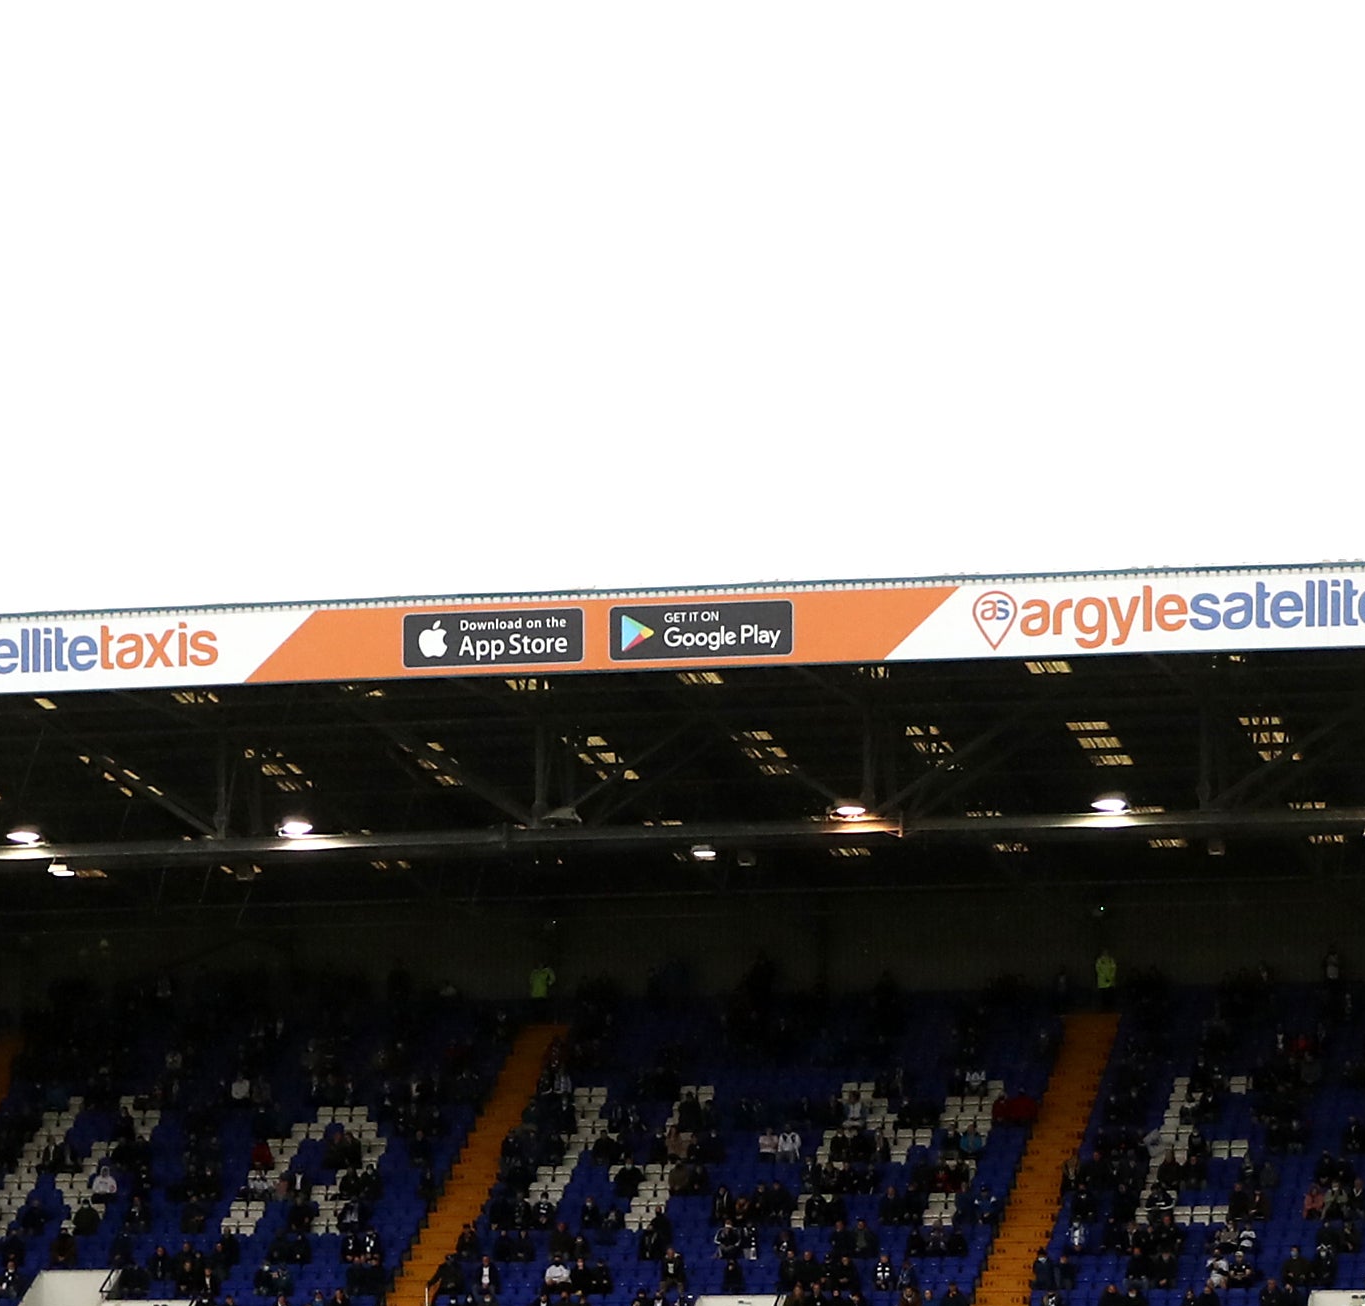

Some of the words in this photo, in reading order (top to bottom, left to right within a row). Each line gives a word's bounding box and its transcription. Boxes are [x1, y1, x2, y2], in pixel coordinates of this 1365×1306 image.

[460, 618, 523, 631] Download
[527, 620, 541, 629] on
[545, 616, 566, 629] the
[664, 612, 686, 623] GET
[688, 612, 699, 622] IT
[700, 612, 719, 622] ON
[459, 634, 505, 661] App
[509, 632, 568, 656] Store
[664, 626, 736, 651] Google
[740, 624, 781, 649] Play
